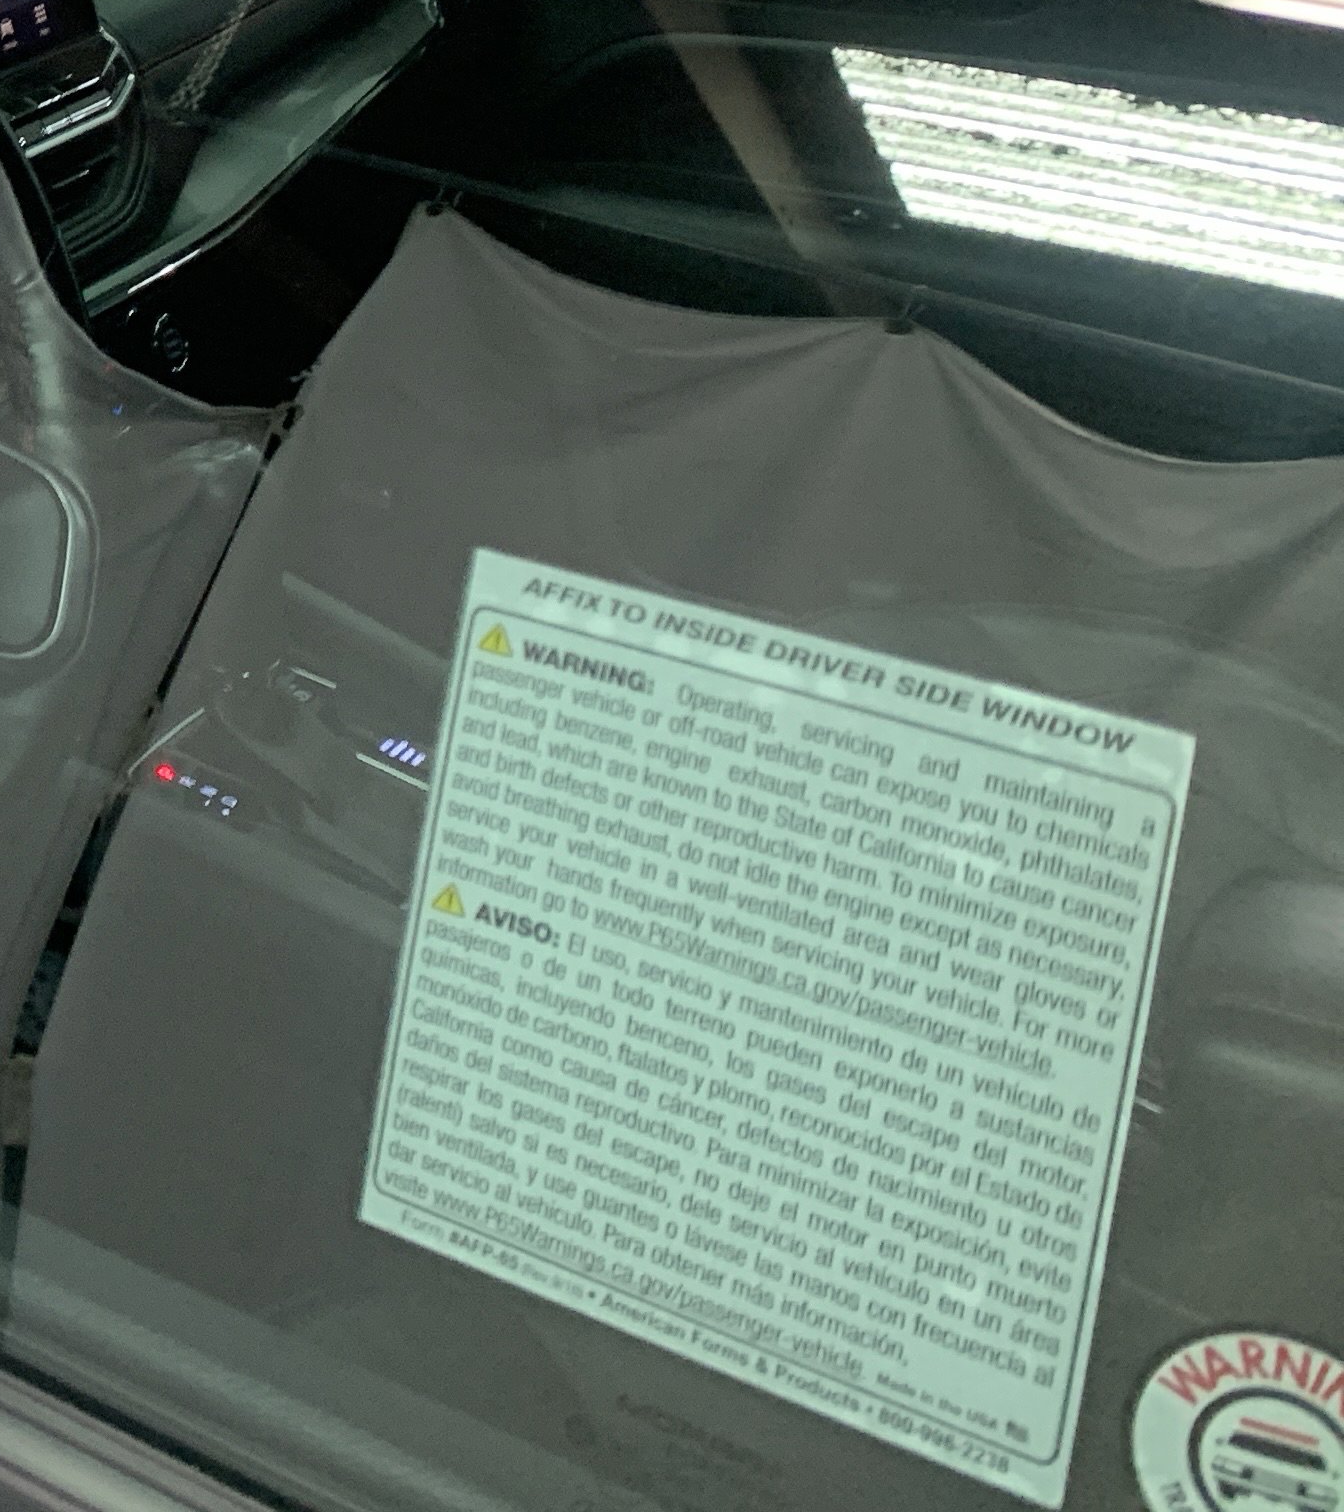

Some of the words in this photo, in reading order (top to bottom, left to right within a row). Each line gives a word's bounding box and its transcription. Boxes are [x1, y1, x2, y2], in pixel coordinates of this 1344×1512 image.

[521, 577, 602, 612] AFFIX
[609, 597, 647, 624] TO
[652, 610, 757, 653] INSIDE
[762, 639, 886, 688] DRIVER
[894, 674, 973, 713] SIDE
[981, 695, 1137, 753] WINDOW
[522, 638, 654, 695] WARNING:
[917, 753, 960, 782] and
[571, 687, 636, 721] vehicle
[667, 714, 748, 753] off-road
[753, 739, 824, 775] vehicle
[829, 762, 869, 788] can
[875, 775, 951, 813] expose
[957, 798, 998, 826] you
[644, 739, 711, 774] engine
[819, 791, 892, 827] carbon
[494, 751, 536, 781] birth
[539, 766, 608, 804] defects
[637, 798, 689, 828] other
[917, 884, 1017, 930] minimize
[547, 741, 603, 771] which
[605, 758, 638, 783] are
[641, 765, 708, 804] known
[737, 794, 769, 823] the
[774, 804, 827, 840] State
[988, 874, 1055, 909] cause
[1060, 895, 1138, 934] cancer
[707, 851, 740, 876] not
[743, 857, 781, 888] idle
[786, 871, 818, 901] the
[823, 887, 894, 926] engine
[899, 912, 970, 949] except
[473, 901, 560, 948] AVISO:
[492, 844, 535, 871] your
[545, 856, 603, 894] hands
[710, 914, 766, 948] when
[869, 967, 918, 996] your
[1012, 1004, 1049, 1040] For
[1054, 1027, 1114, 1063] more
[516, 822, 559, 848] your
[566, 837, 631, 873] vehicle
[842, 926, 890, 957] area
[898, 944, 940, 972] and
[950, 959, 1004, 992] wear
[1013, 980, 1086, 1020] gloves
